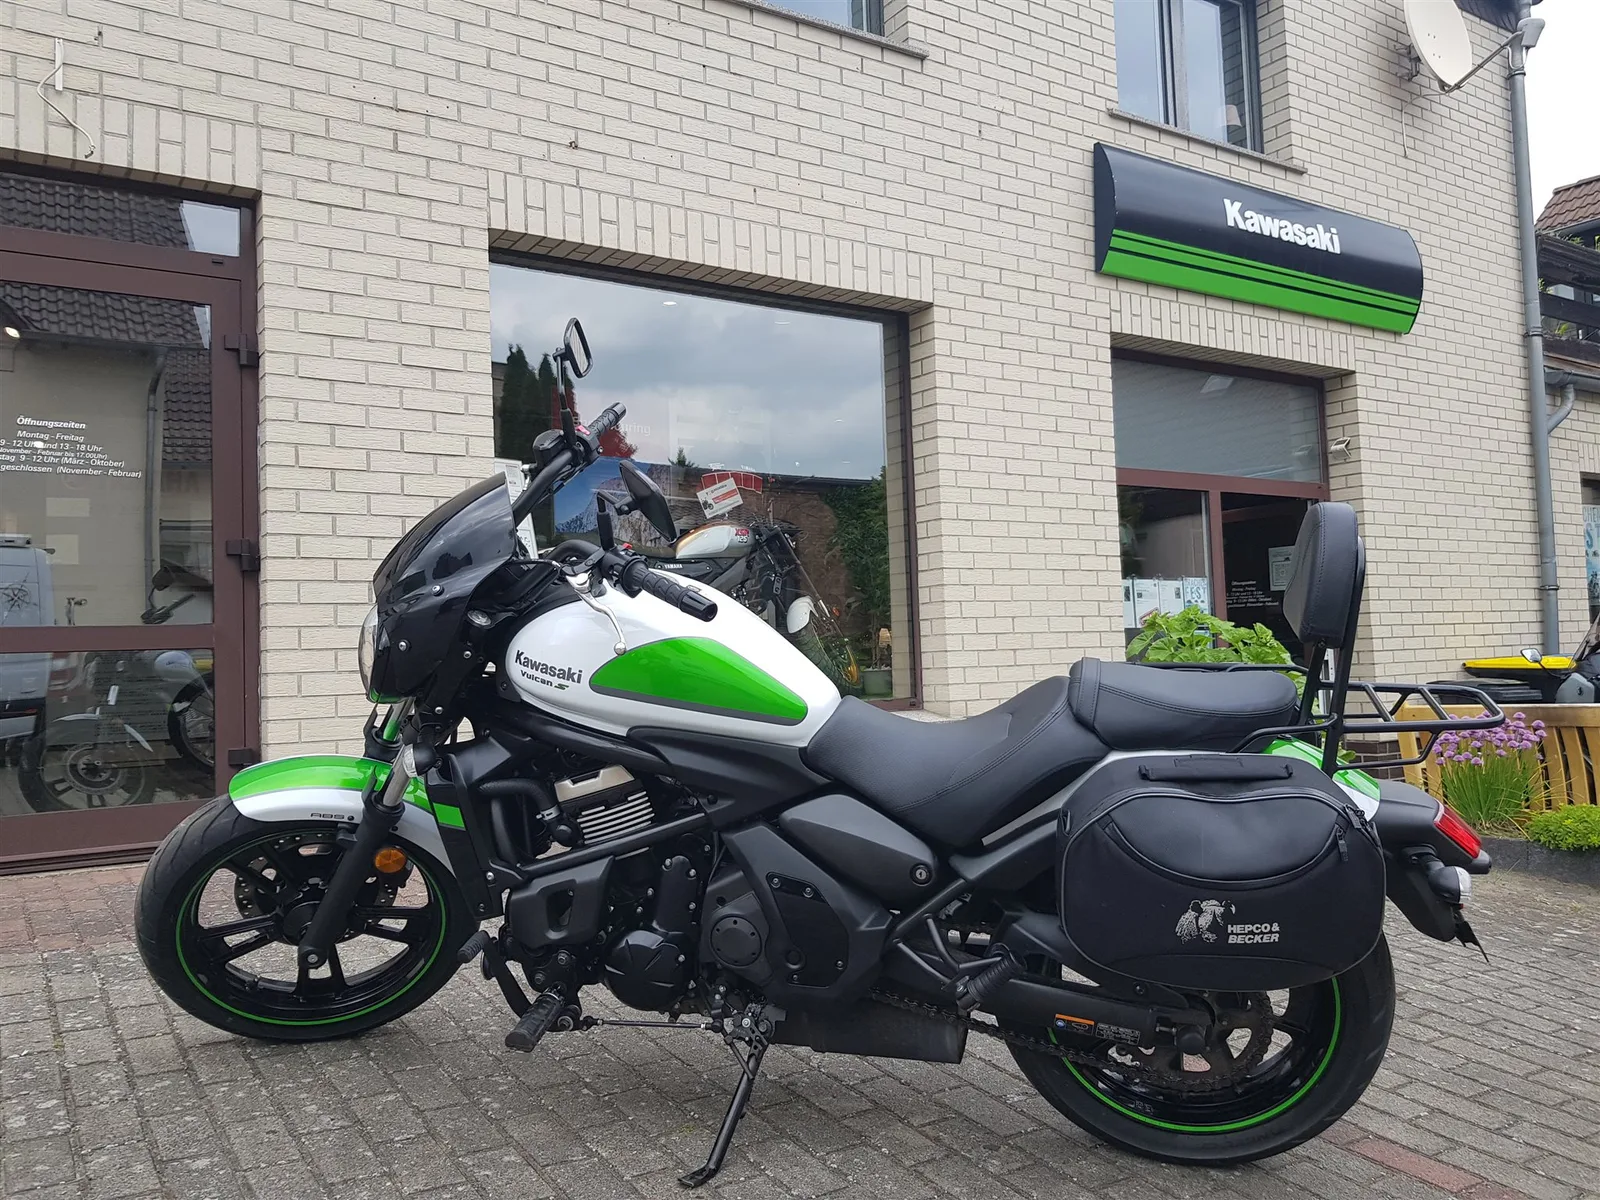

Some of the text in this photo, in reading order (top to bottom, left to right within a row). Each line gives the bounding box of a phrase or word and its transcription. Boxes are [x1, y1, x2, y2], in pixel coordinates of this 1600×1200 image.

[1223, 198, 1341, 254] Kawasaki
[16, 415, 86, 429] Öffnungszeiten
[17, 430, 50, 441] Montag
[55, 433, 85, 443] Freitag
[24, 440, 38, 448] Uh
[90, 459, 125, 468] Oktober)
[0, 463, 53, 473] geschlossen
[56, 466, 102, 476] (November
[108, 468, 142, 478] Februar)
[515, 650, 582, 683] Kawasaki
[520, 670, 553, 687] Vulcan
[1227, 923, 1270, 934] HEPCO
[1227, 933, 1280, 944] BECKER
